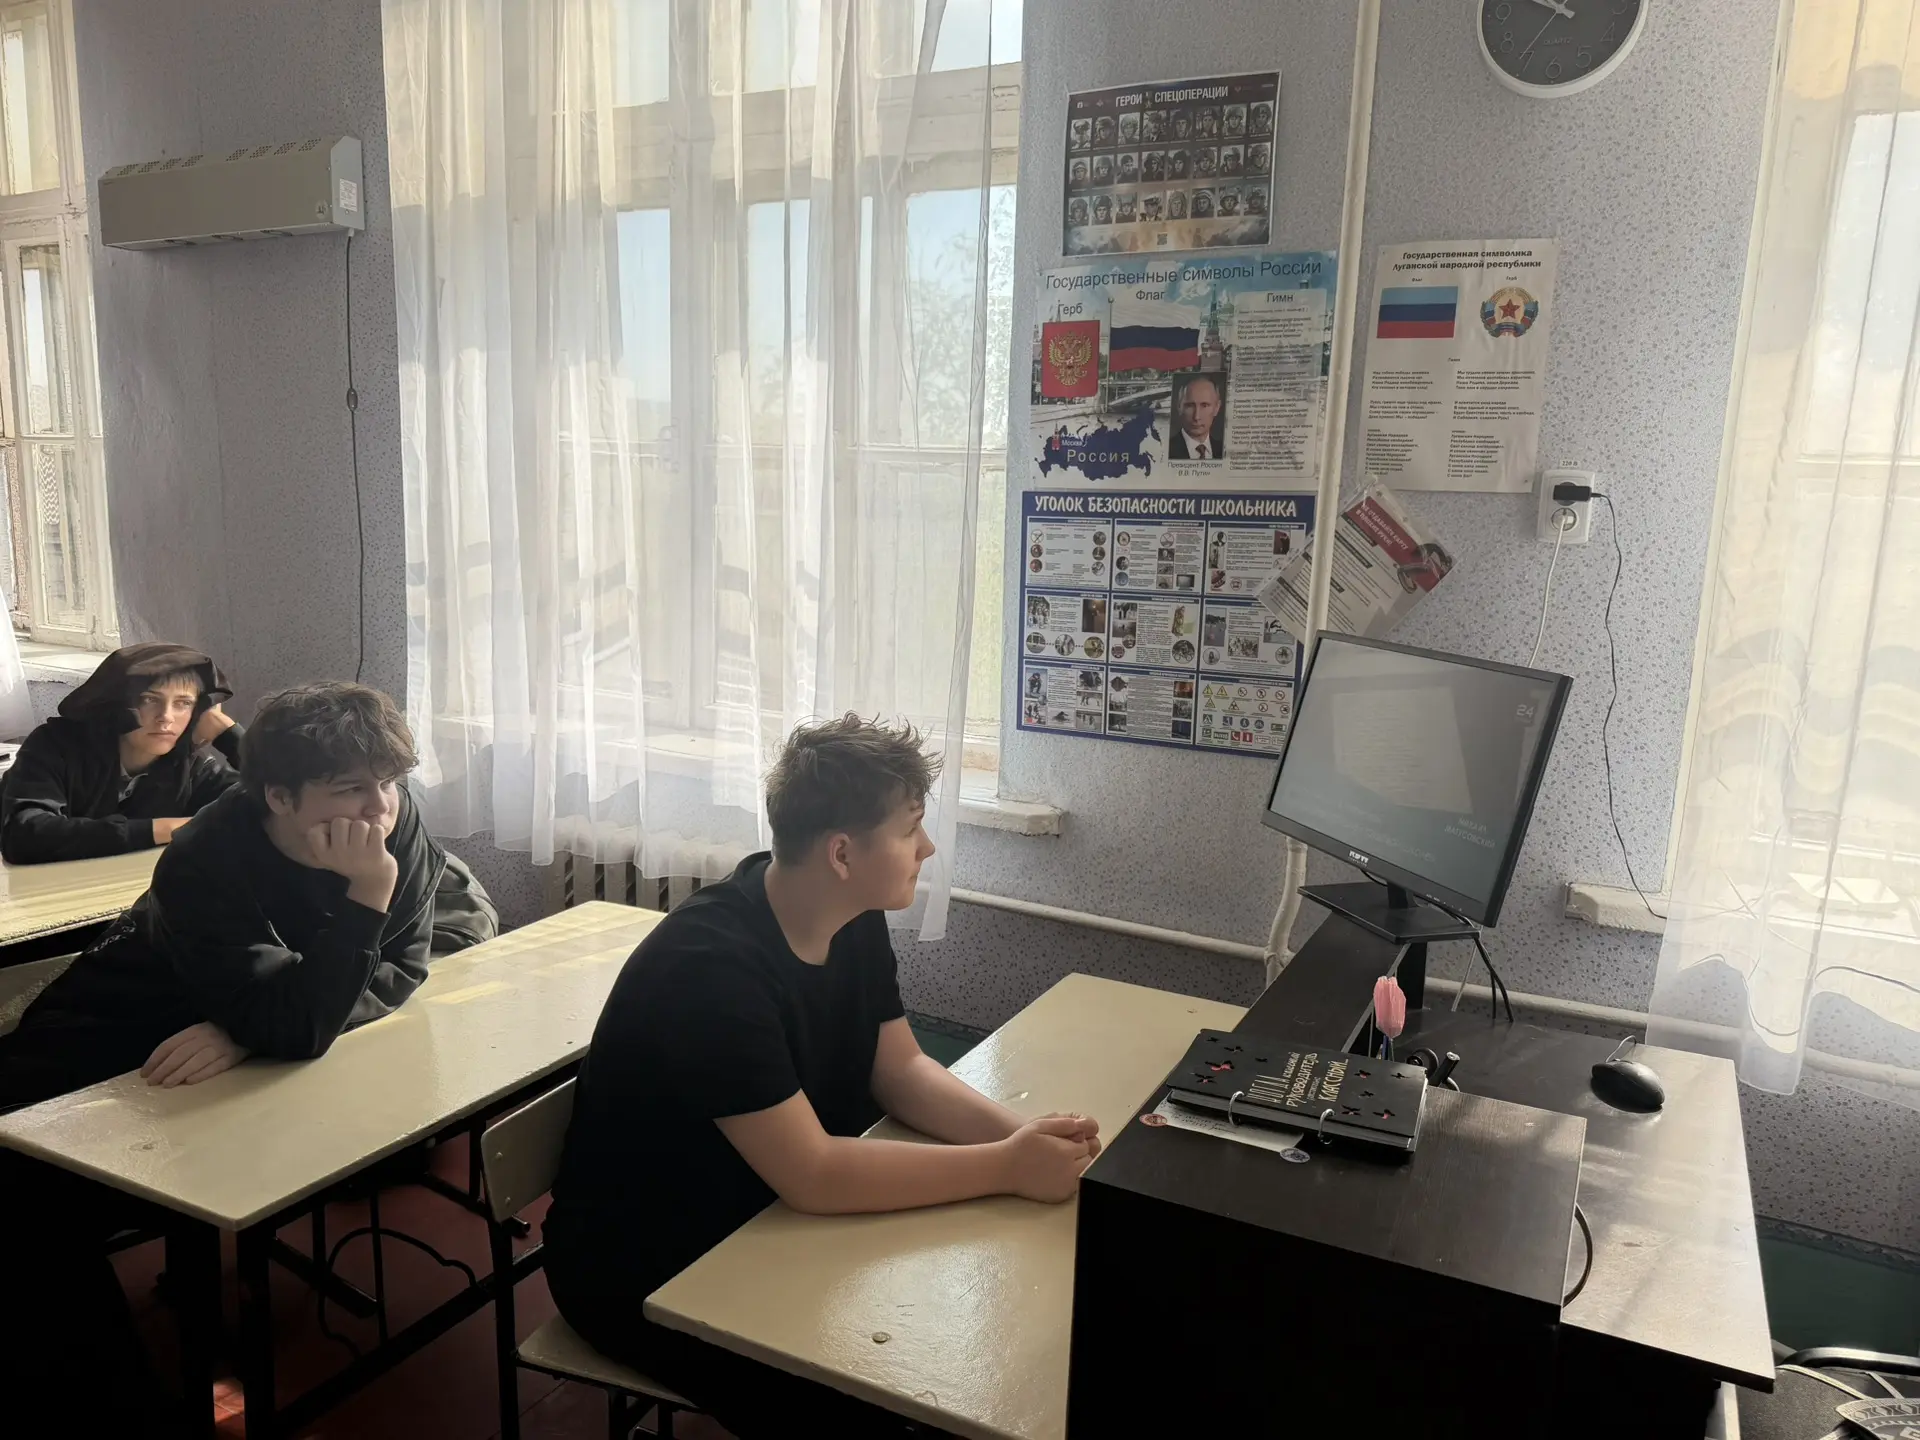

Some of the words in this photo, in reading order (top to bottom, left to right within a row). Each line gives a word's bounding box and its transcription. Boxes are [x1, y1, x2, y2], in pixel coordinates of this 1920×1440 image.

[1496, 3, 1511, 25] 9
[1500, 31, 1514, 53] 8
[1600, 22, 1615, 42] 4
[1520, 51, 1535, 73] 7
[1545, 56, 1562, 79] 6
[1575, 45, 1592, 69] 5
[1115, 94, 1143, 108] ГЕРОИ
[1154, 86, 1229, 104] СПЕЦОПЕРАЦИИ
[1393, 261, 1438, 271] Луганской
[1440, 260, 1485, 270] народной
[1486, 259, 1542, 270] республики
[1402, 252, 1479, 261] Государственная
[1480, 250, 1533, 258] символика
[1046, 269, 1178, 291] Государственные
[1182, 264, 1254, 283] символы
[1260, 260, 1321, 277] России
[1136, 289, 1165, 301] Флаг
[1267, 292, 1294, 303] Гимн
[1057, 302, 1083, 317] Герб
[1067, 449, 1130, 464] Россия
[1035, 495, 1084, 513] УГОЛОК
[1088, 497, 1196, 516] БЕЗОПАСНОСТИ
[1200, 498, 1298, 518] ШКОЛЬНИКА
[1516, 704, 1534, 718] 24
[1285, 1052, 1319, 1108] РУКОВОДИТЕЛЬ
